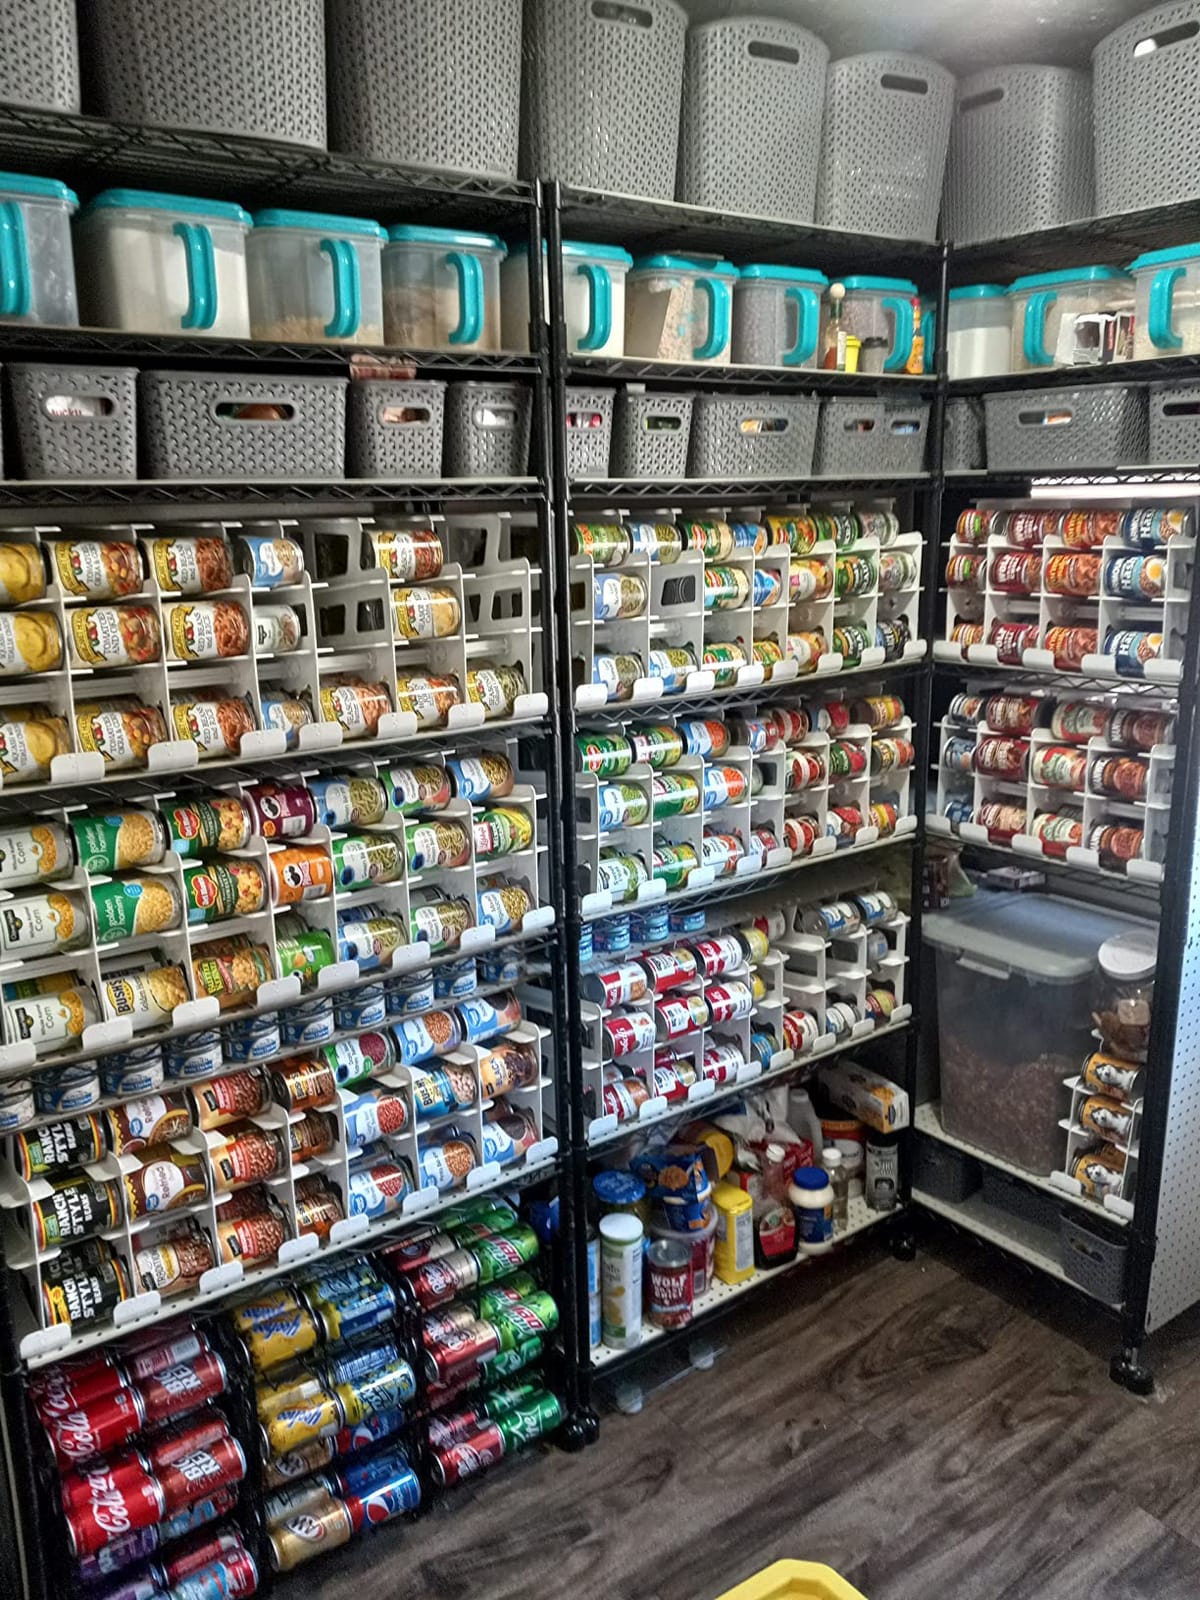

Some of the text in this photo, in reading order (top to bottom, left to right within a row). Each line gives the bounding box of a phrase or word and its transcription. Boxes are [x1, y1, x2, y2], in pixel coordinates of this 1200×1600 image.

[177, 544, 186, 567] BEANS
[185, 546, 193, 565] RICE
[997, 554, 1010, 583] WOLF
[1122, 557, 1133, 590] Hash
[98, 611, 111, 655] TOMATOES
[194, 612, 206, 652] RED BEANS
[203, 615, 212, 635] RICE
[15, 841, 27, 864] Corn
[85, 826, 99, 854] golden
[94, 823, 107, 854] hominy
[32, 909, 44, 932] Corn
[105, 899, 117, 927] golden
[114, 895, 126, 925] hominy
[108, 978, 132, 1013] BUSH'S
[43, 1006, 55, 1029] Corn
[65, 1123, 77, 1149] BEANS
[156, 1167, 171, 1199] Refried
[52, 1193, 72, 1236] RANCH
[65, 1187, 85, 1235] STYLE
[79, 1193, 93, 1222] BEANS
[151, 1247, 167, 1286] TRADITION
[651, 1273, 688, 1287] WOLF
[63, 1277, 82, 1320] RANCH
[75, 1272, 94, 1318] STYLE
[90, 1276, 103, 1303] BEANS
[57, 1411, 97, 1460] Cola
